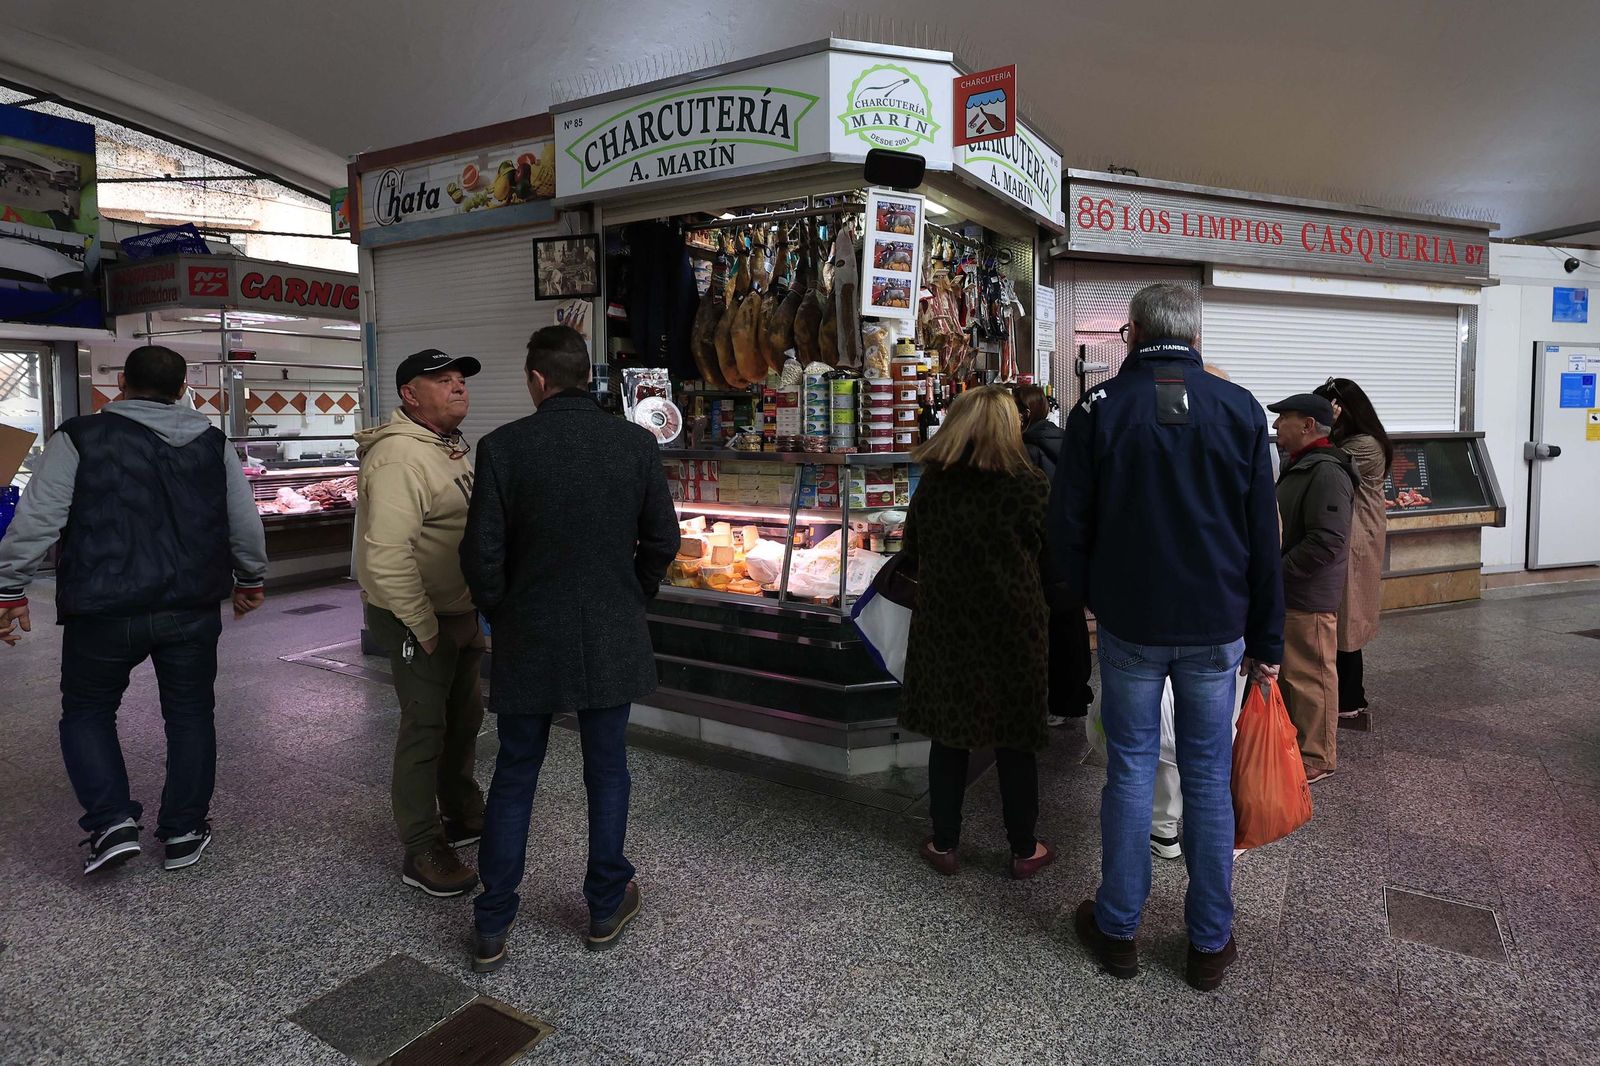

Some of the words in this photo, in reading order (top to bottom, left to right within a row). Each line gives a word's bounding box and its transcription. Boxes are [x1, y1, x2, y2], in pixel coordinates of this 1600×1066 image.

[961, 71, 1012, 89] CHARCUTERÍA
[855, 98, 925, 116] CHARCUTERÍA
[564, 120, 573, 130] Nº
[574, 118, 583, 128] 85
[585, 87, 791, 173] CHARCUTERÍA
[851, 113, 928, 134] MARÍN
[870, 133, 893, 146] DESDE
[895, 137, 910, 146] 2001
[629, 161, 650, 182] A.
[657, 138, 736, 178] MARÍN
[968, 134, 1050, 205] RCUTERÍA
[386, 174, 396, 188] La
[990, 164, 1001, 187] A.
[1003, 178, 1034, 207] MARÍN
[373, 168, 440, 227] Chata
[1077, 196, 1115, 231] 86
[1122, 206, 1171, 234] LOS
[1181, 212, 1284, 245] LIMPIOS
[1301, 222, 1458, 264] CASQUERIA
[1465, 245, 1484, 265] 87
[194, 271, 226, 280] Nº
[194, 282, 224, 293] 17
[240, 271, 359, 310] CARNIC
[1140, 345, 1161, 353] HELLY
[1162, 344, 1190, 352] HANSEN
